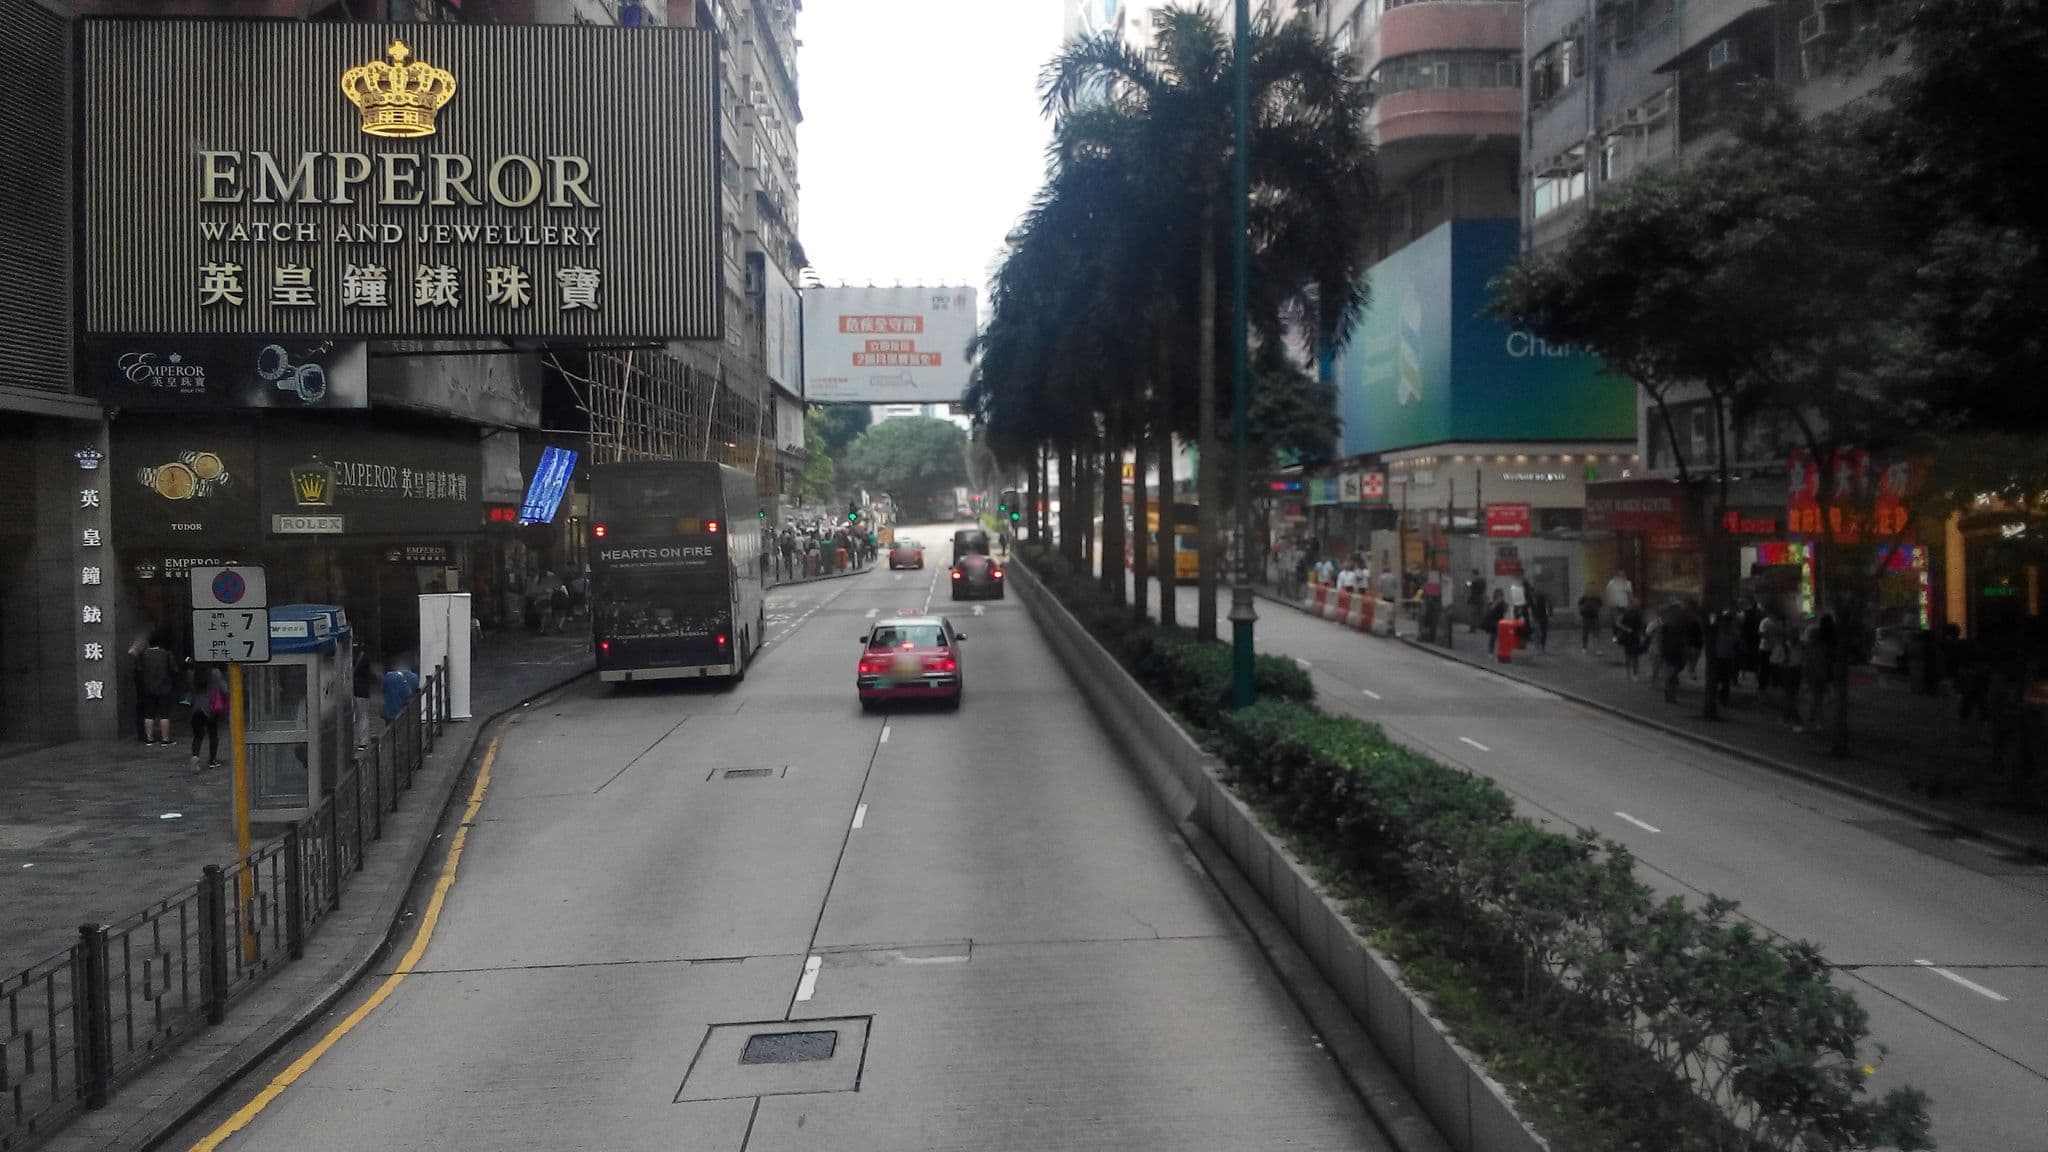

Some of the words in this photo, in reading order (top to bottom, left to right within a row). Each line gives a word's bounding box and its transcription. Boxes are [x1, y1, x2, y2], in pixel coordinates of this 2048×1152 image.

[199, 150, 601, 208] EMPEROR
[200, 220, 318, 243] WATCH
[335, 222, 403, 243] AND
[418, 223, 601, 247] JEWELLERY
[197, 260, 603, 312] 英皇鐘錶珠寶
[334, 460, 398, 489] EMPEROR
[171, 523, 203, 531] TUDOR
[282, 518, 341, 529] ROLEX
[600, 549, 658, 561] HEARTS
[659, 547, 681, 557] ON
[682, 546, 713, 557] FIRE
[80, 489, 104, 701] 英皇鐘錶珠寶
[208, 621, 230, 632] 上午
[241, 613, 254, 630] 7
[212, 640, 227, 649] pm
[242, 641, 255, 658] 7
